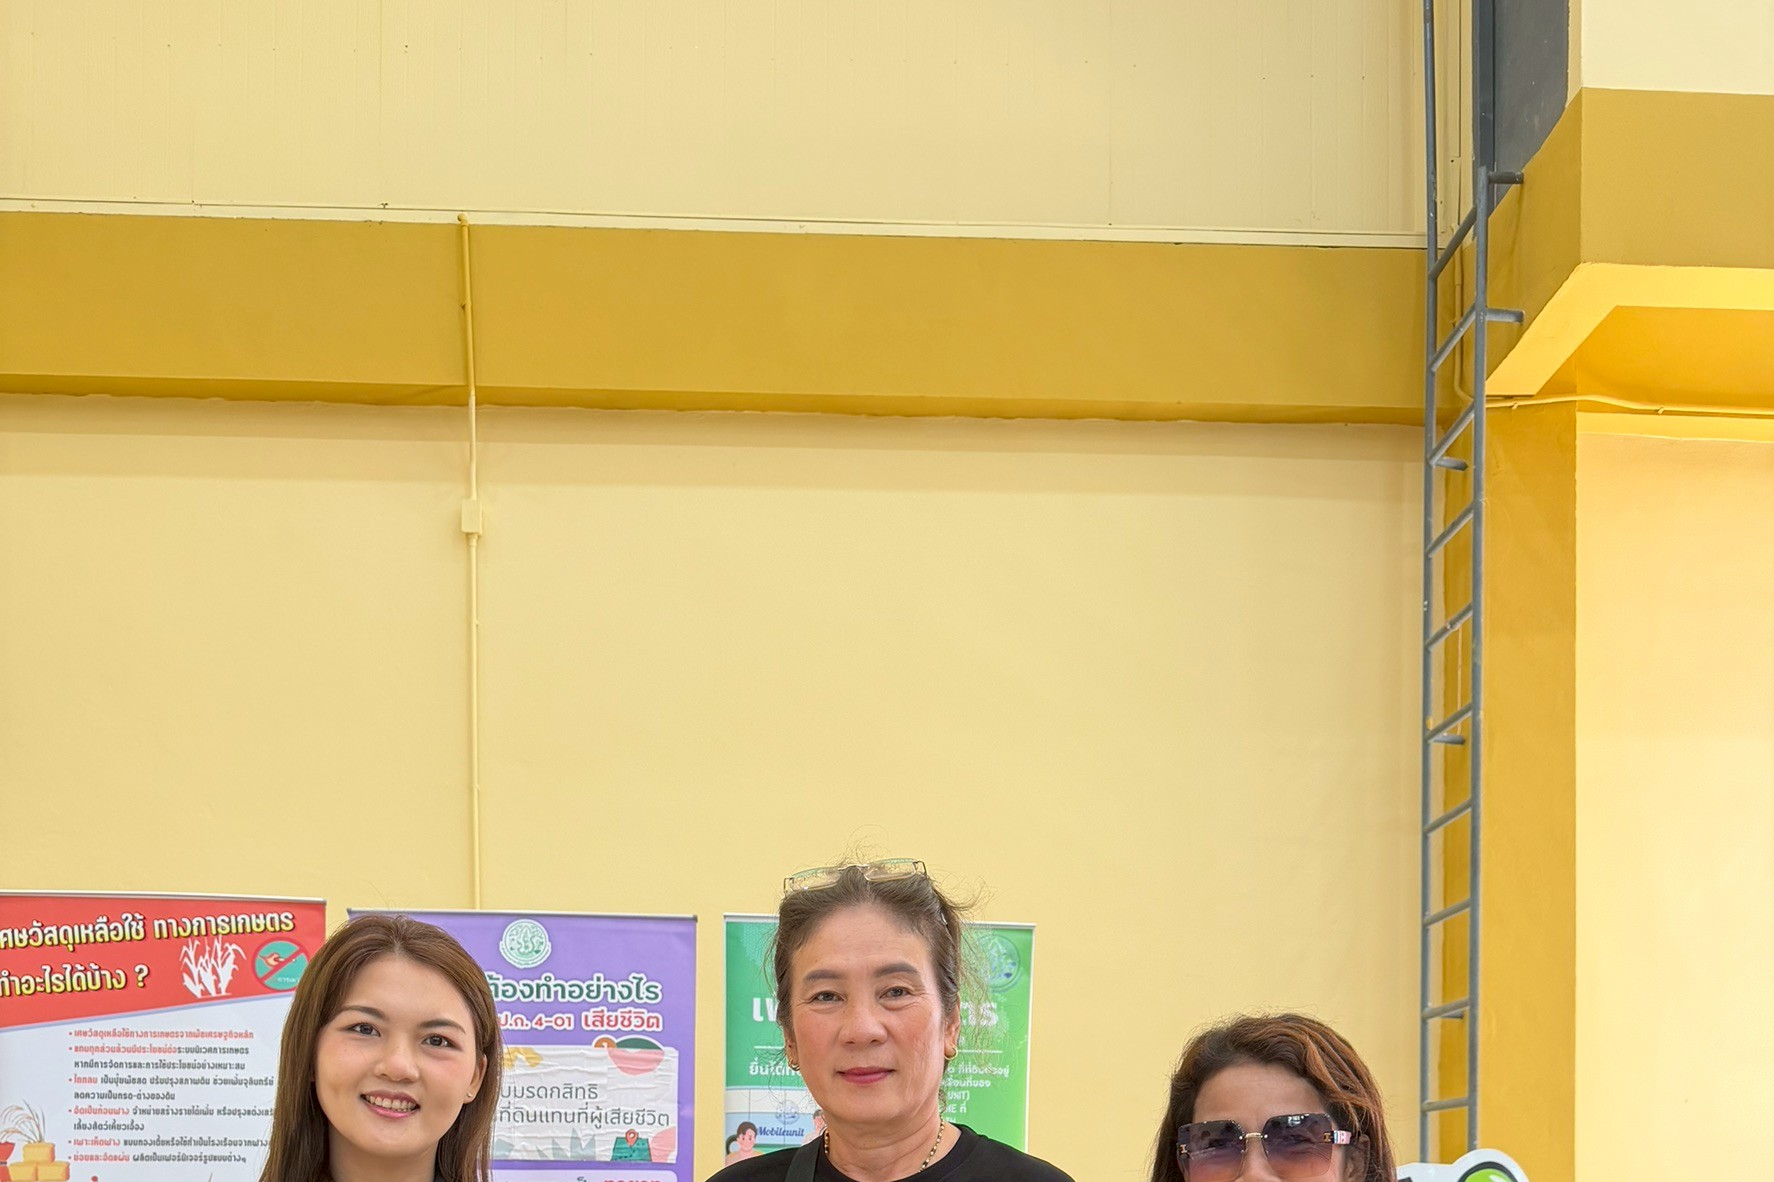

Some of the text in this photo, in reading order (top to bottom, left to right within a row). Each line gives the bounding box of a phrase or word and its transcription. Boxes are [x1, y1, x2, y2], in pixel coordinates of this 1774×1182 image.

[0, 911, 295, 952] ศษวัสดุเหลือใช้ ทางการเกษตร
[534, 1014, 573, 1028] 4-01
[583, 1009, 661, 1029] เสียชีวิต
[499, 1100, 670, 1130] ที่ดินแทนที่ผู้เสียชีวิต
